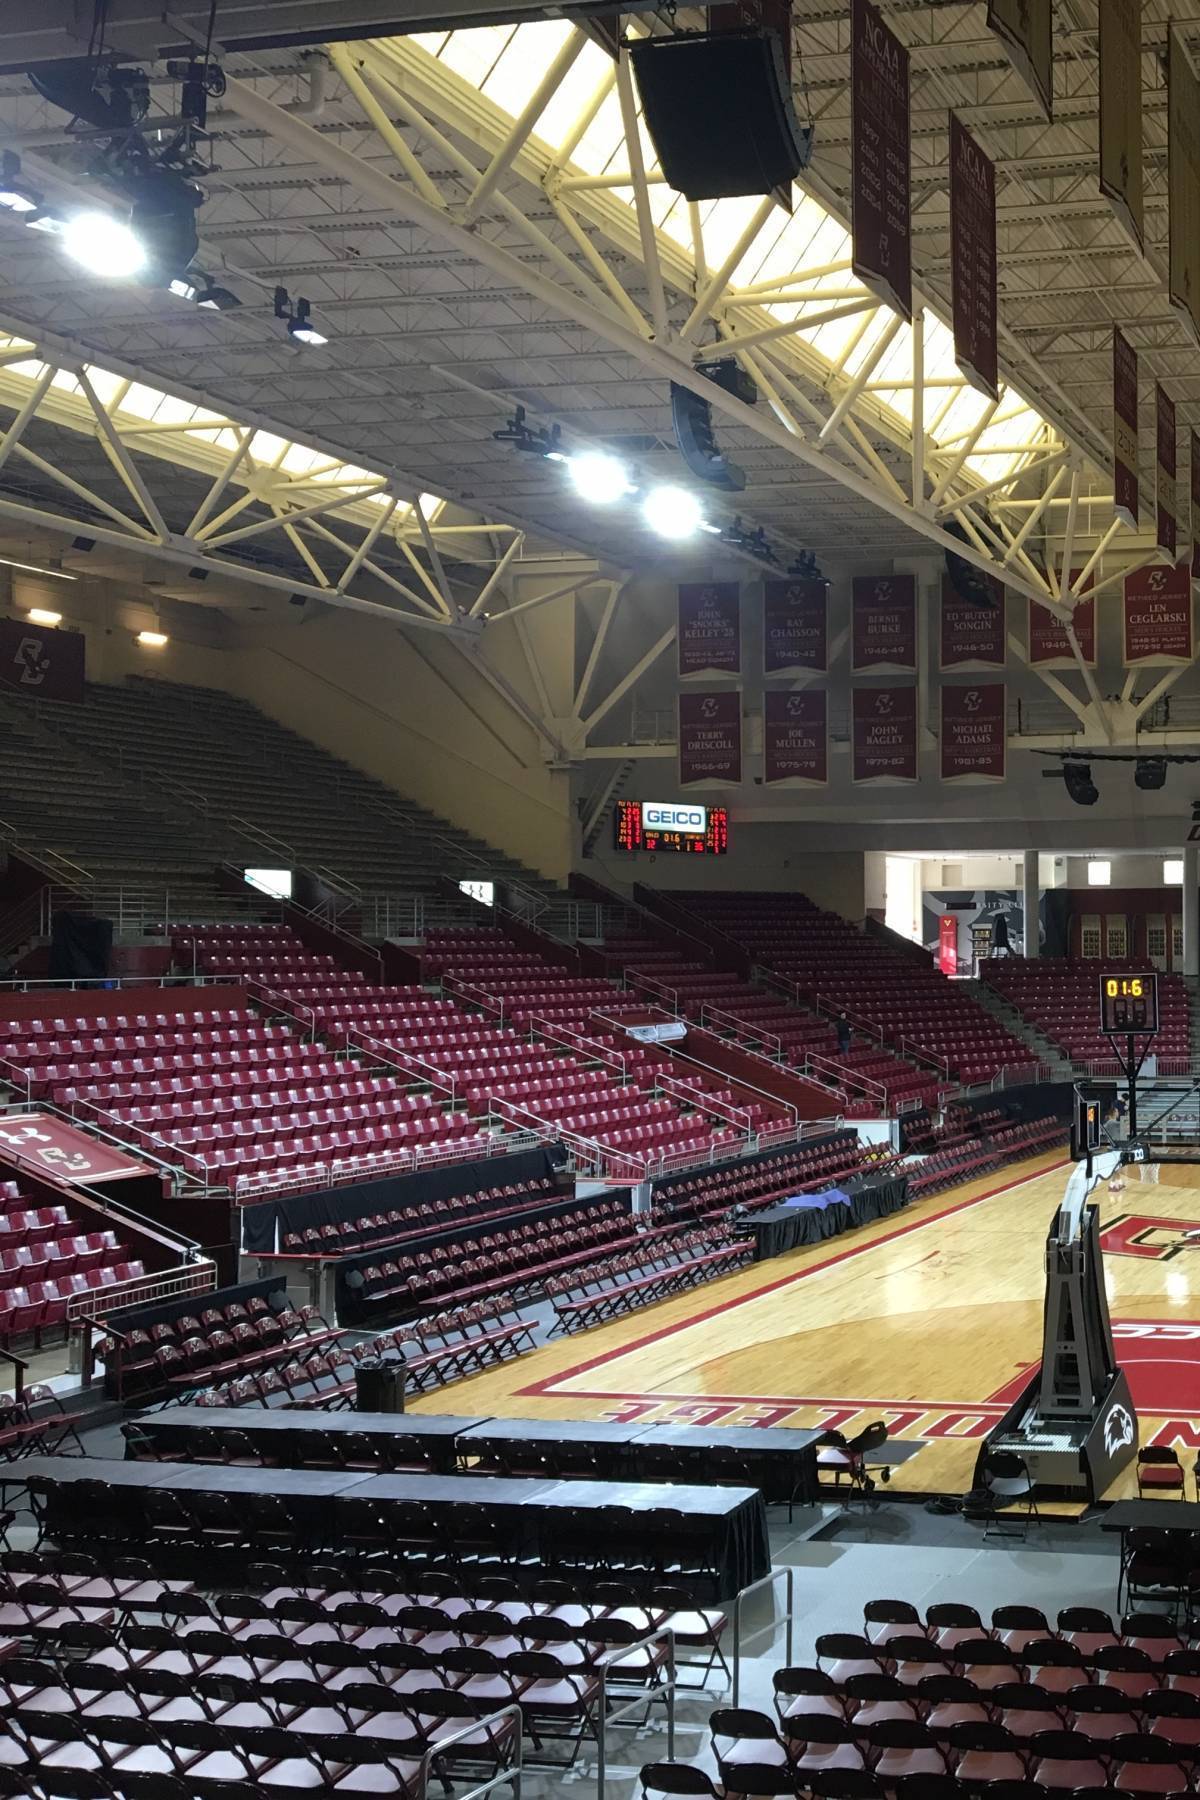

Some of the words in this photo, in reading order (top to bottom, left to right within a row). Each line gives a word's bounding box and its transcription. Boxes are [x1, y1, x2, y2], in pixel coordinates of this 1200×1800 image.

[864, 14, 899, 73] NCAA
[960, 134, 988, 190] NCAA
[1149, 603, 1167, 613] LEN
[946, 612, 959, 621] ED
[1129, 613, 1187, 624] CEGLARSKI
[787, 619, 803, 628] RAY
[953, 621, 992, 631] SONGIN
[771, 628, 820, 638] CHAISSON
[868, 624, 901, 634] BURKE
[871, 726, 899, 735] JOHN
[952, 724, 993, 733] MICHAEL
[697, 732, 724, 740] TERRY
[788, 729, 804, 739] JOE
[956, 734, 992, 744] ADAMS
[687, 740, 735, 750] DRISCOLL
[775, 739, 816, 748] MULLEN
[866, 735, 905, 745] BAGLEY
[647, 810, 702, 825] GEICO
